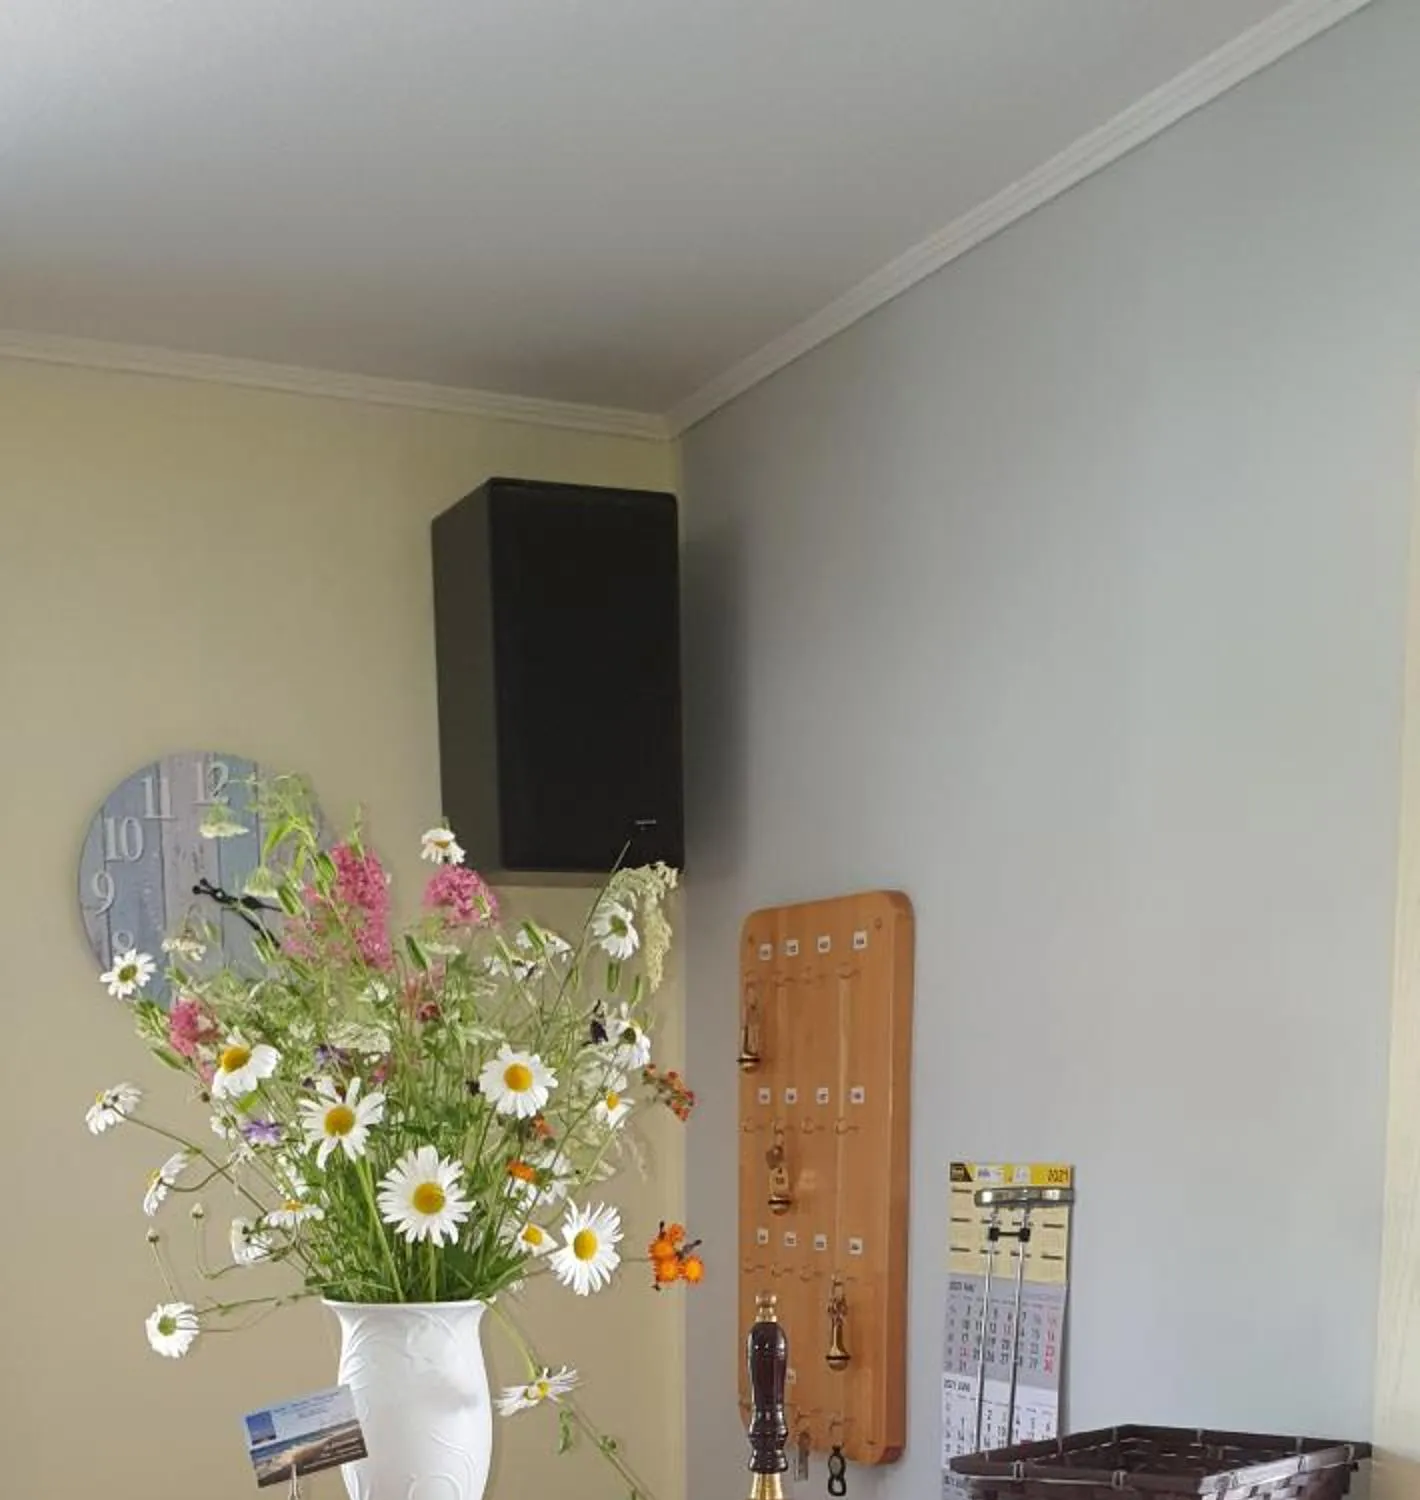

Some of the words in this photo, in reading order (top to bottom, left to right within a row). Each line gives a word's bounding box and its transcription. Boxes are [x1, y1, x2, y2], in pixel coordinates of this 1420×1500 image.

[141, 776, 175, 820] 11
[193, 761, 230, 805] 12
[103, 816, 144, 862] 10
[92, 869, 115, 917] 9
[1047, 1168, 1068, 1183] 2021
